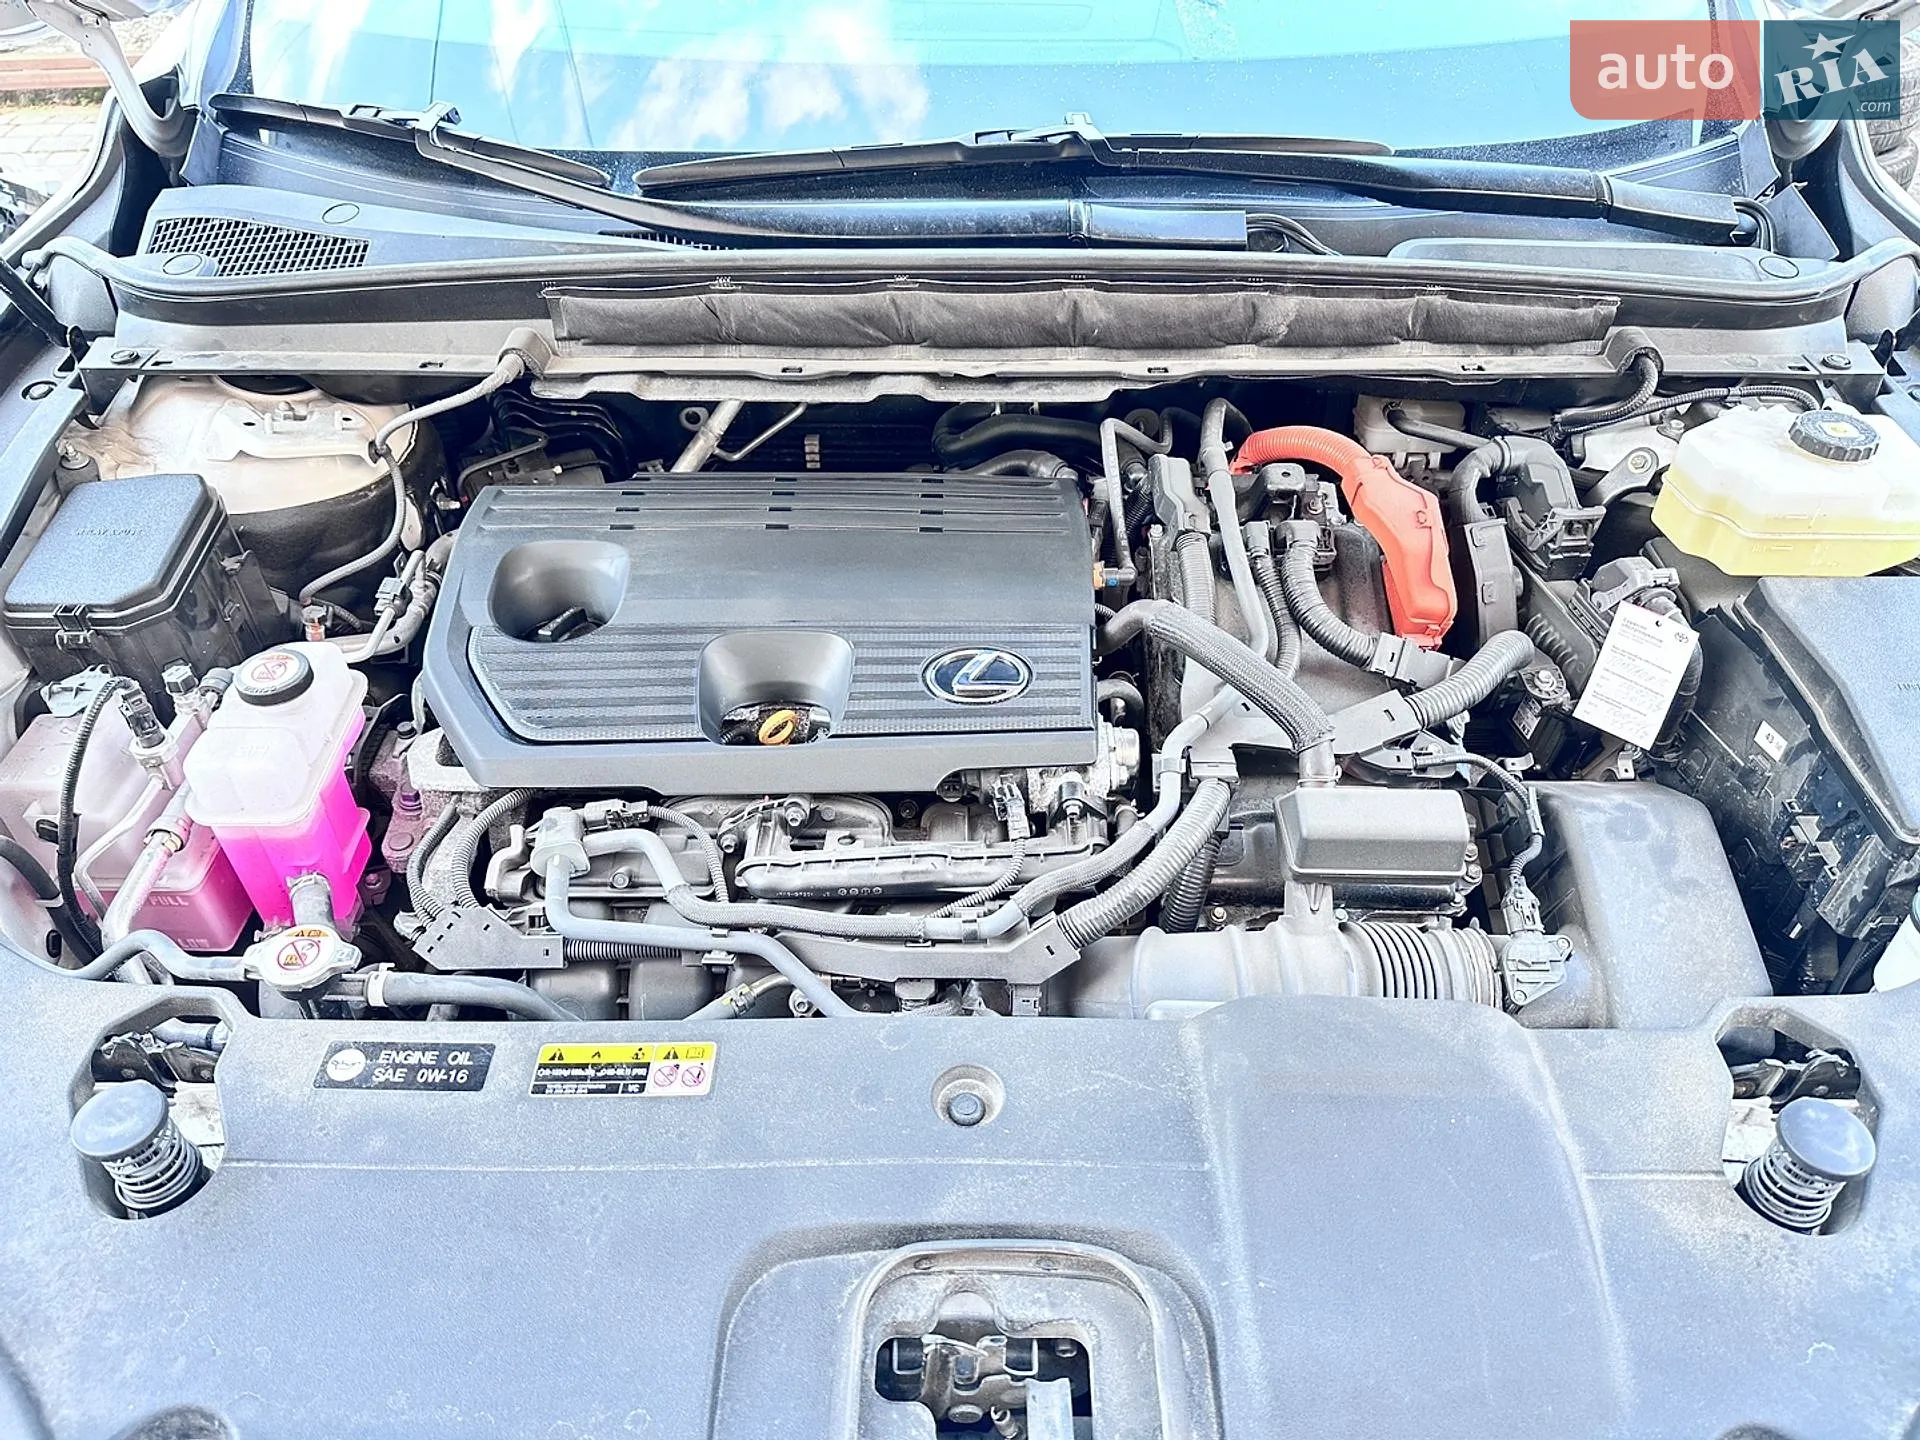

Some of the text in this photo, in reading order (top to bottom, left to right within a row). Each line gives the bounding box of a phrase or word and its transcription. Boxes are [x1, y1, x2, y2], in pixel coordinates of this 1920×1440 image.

[149, 896, 189, 906] FULL
[177, 938, 209, 948] LOW
[378, 1050, 473, 1065] ENGINE OIL
[372, 1068, 468, 1083] SAE 0W-16
